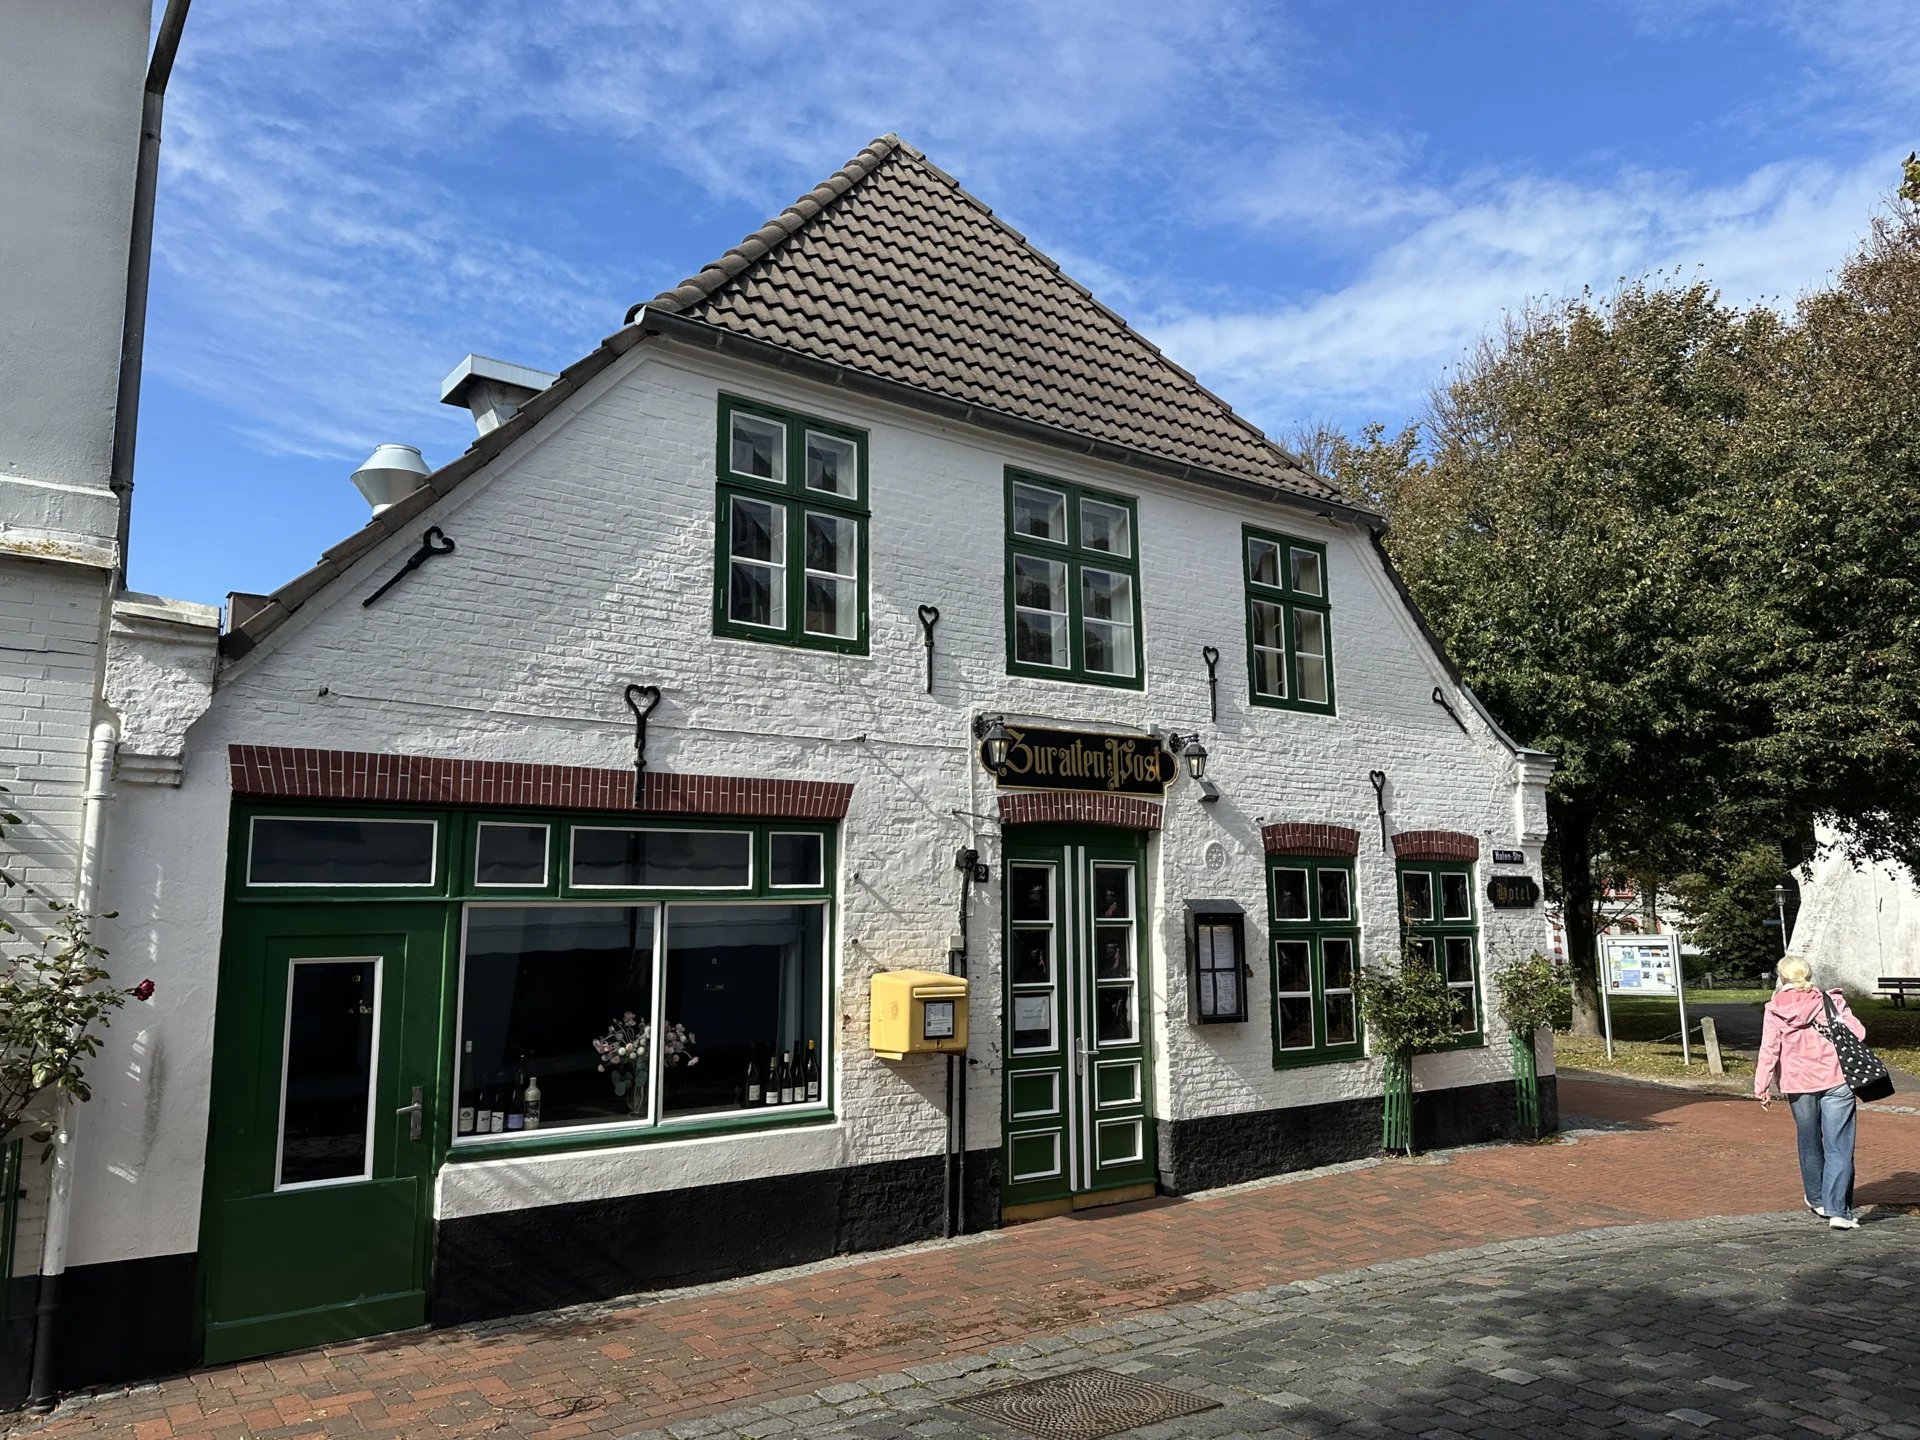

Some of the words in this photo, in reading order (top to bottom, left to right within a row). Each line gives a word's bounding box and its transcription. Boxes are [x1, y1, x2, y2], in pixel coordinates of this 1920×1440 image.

[998, 728, 1057, 777] Zur
[1058, 739, 1106, 778] alten
[1105, 738, 1162, 790] Post
[978, 865, 986, 880] 2
[1496, 883, 1531, 902] Hotel
